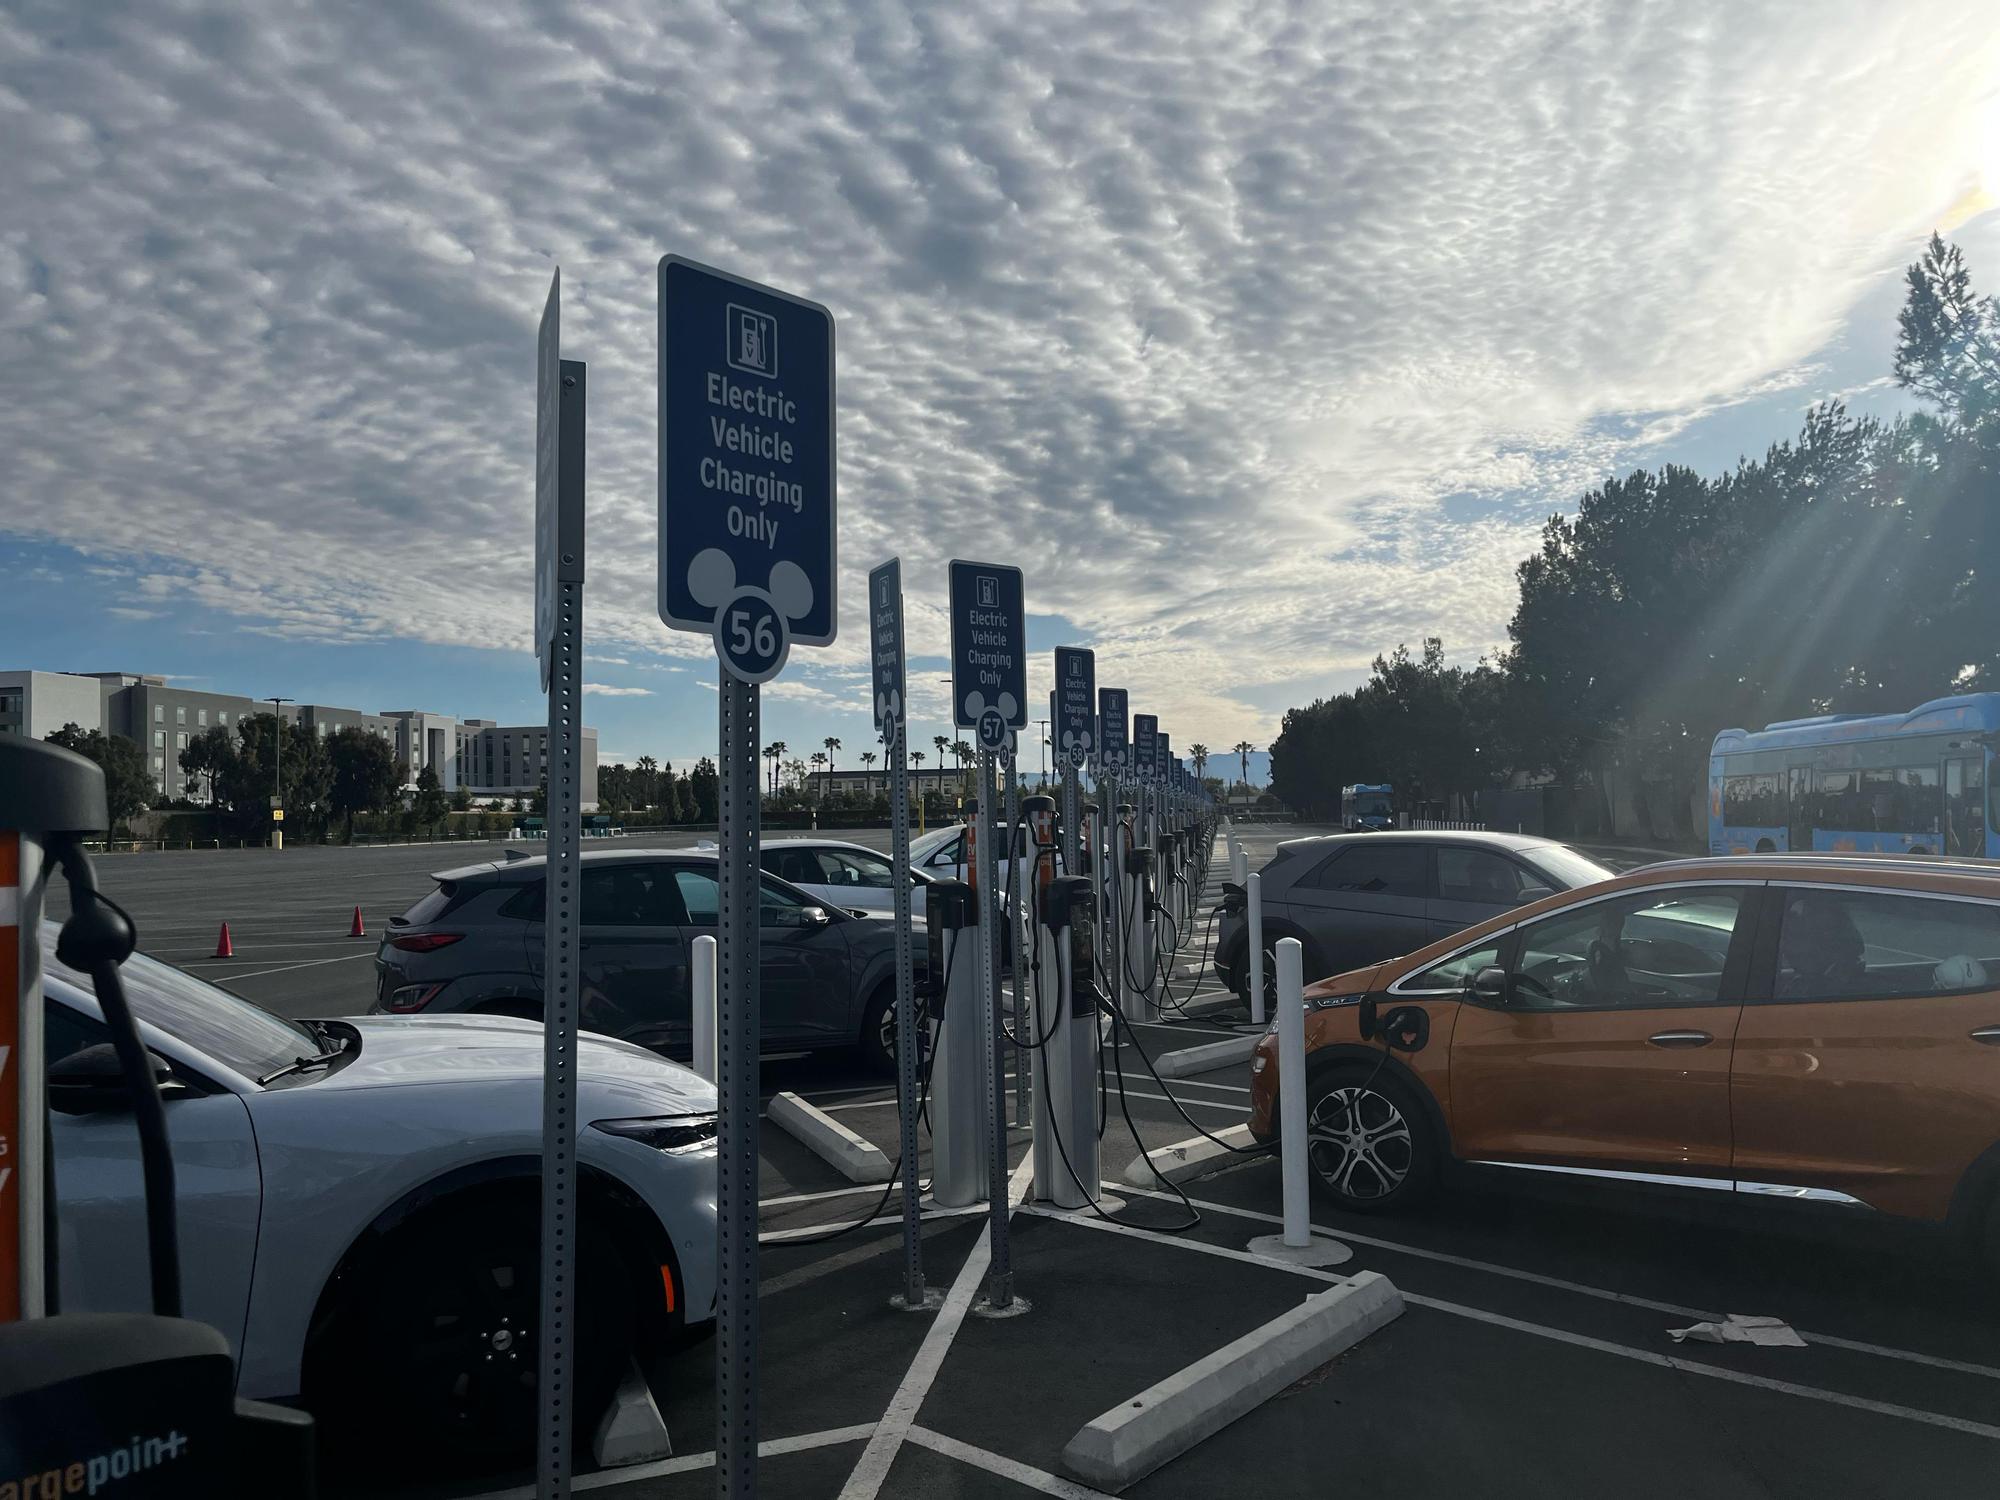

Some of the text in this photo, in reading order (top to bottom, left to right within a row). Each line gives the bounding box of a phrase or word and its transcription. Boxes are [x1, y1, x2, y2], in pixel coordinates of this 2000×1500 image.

[707, 372, 796, 424] Electric
[710, 416, 793, 464] Vehicle
[700, 457, 803, 513] Charging
[727, 506, 778, 549] Only
[970, 610, 1008, 627] Electric
[729, 611, 776, 659] 56
[972, 630, 1007, 646] Vehicle
[968, 650, 1012, 669] Charging
[980, 670, 1002, 688] Only
[983, 718, 1001, 739] 57
[1072, 748, 1083, 762] 58
[1111, 763, 1119, 773] 59
